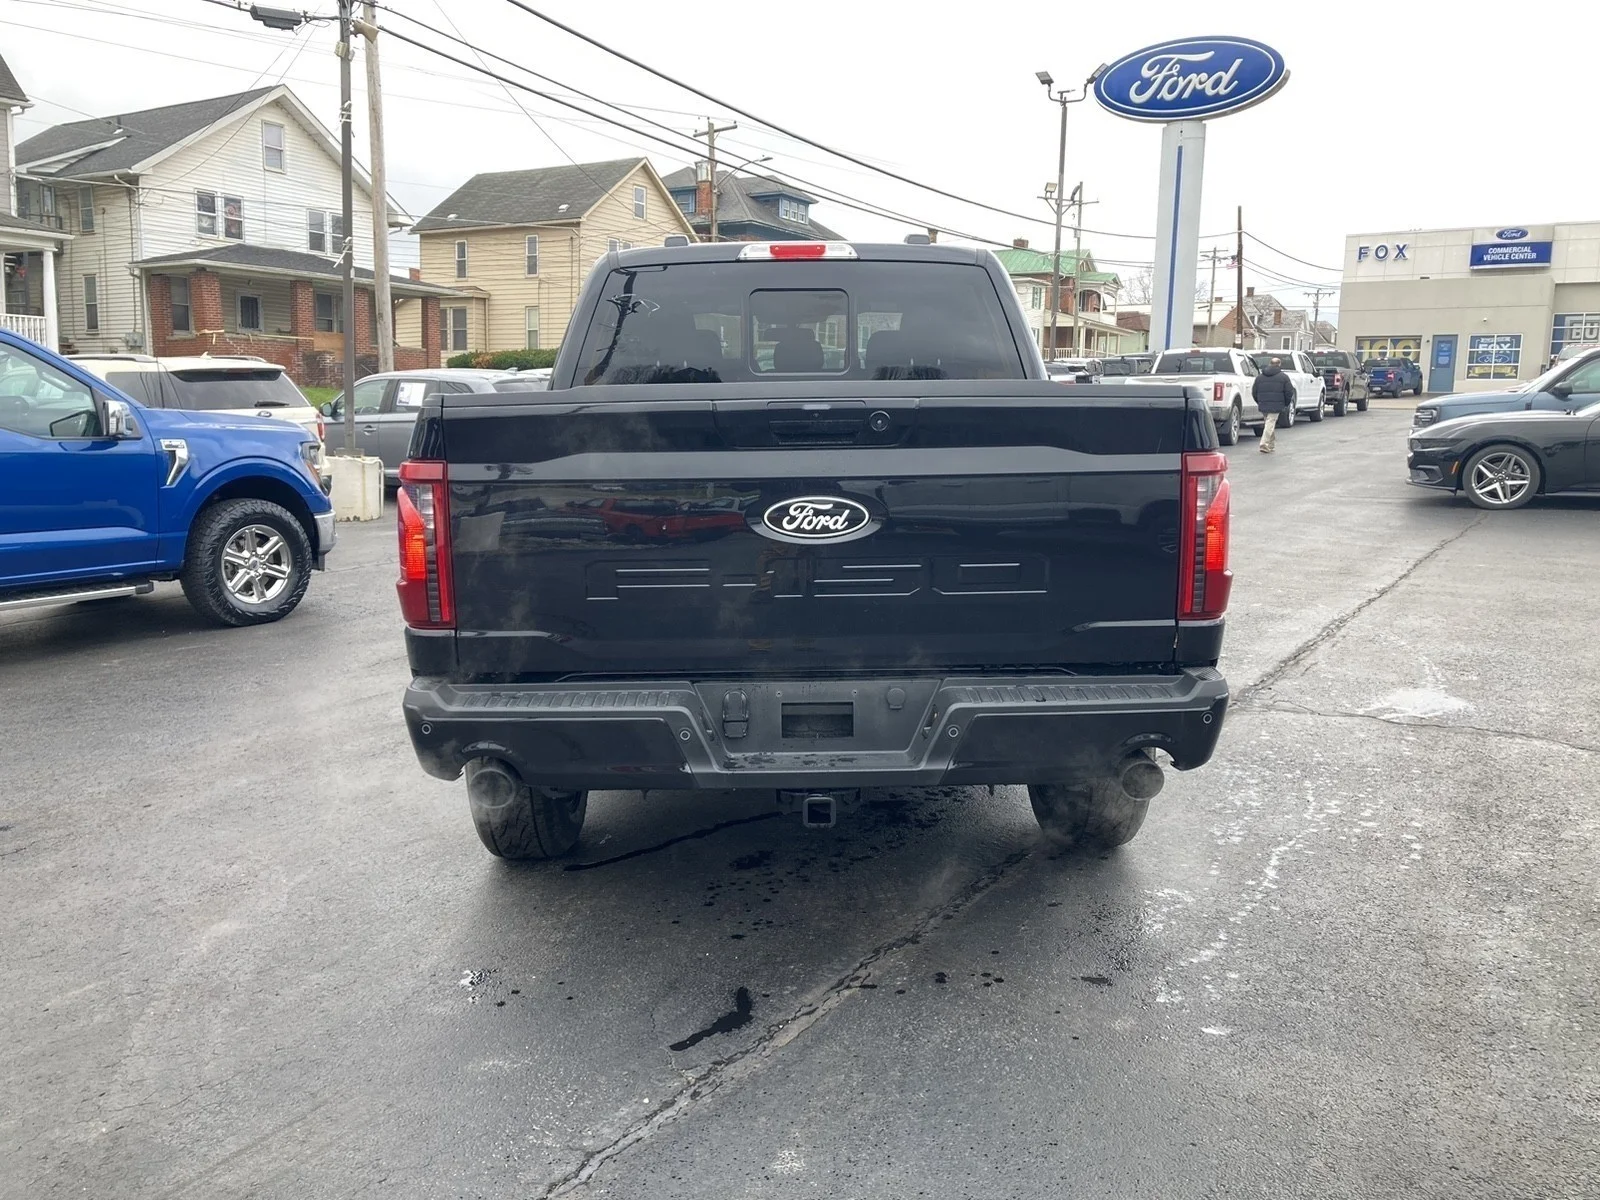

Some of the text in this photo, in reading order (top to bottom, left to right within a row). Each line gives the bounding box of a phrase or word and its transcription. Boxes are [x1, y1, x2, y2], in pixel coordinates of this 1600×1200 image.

[1129, 50, 1243, 104] Ford
[1502, 229, 1521, 238] Ford
[1357, 243, 1409, 261] FOX
[1488, 246, 1532, 254] COMMERCIAL
[1483, 252, 1537, 261] VEHICLE CENTER
[1478, 343, 1511, 353] FOX
[782, 502, 850, 530] Ford
